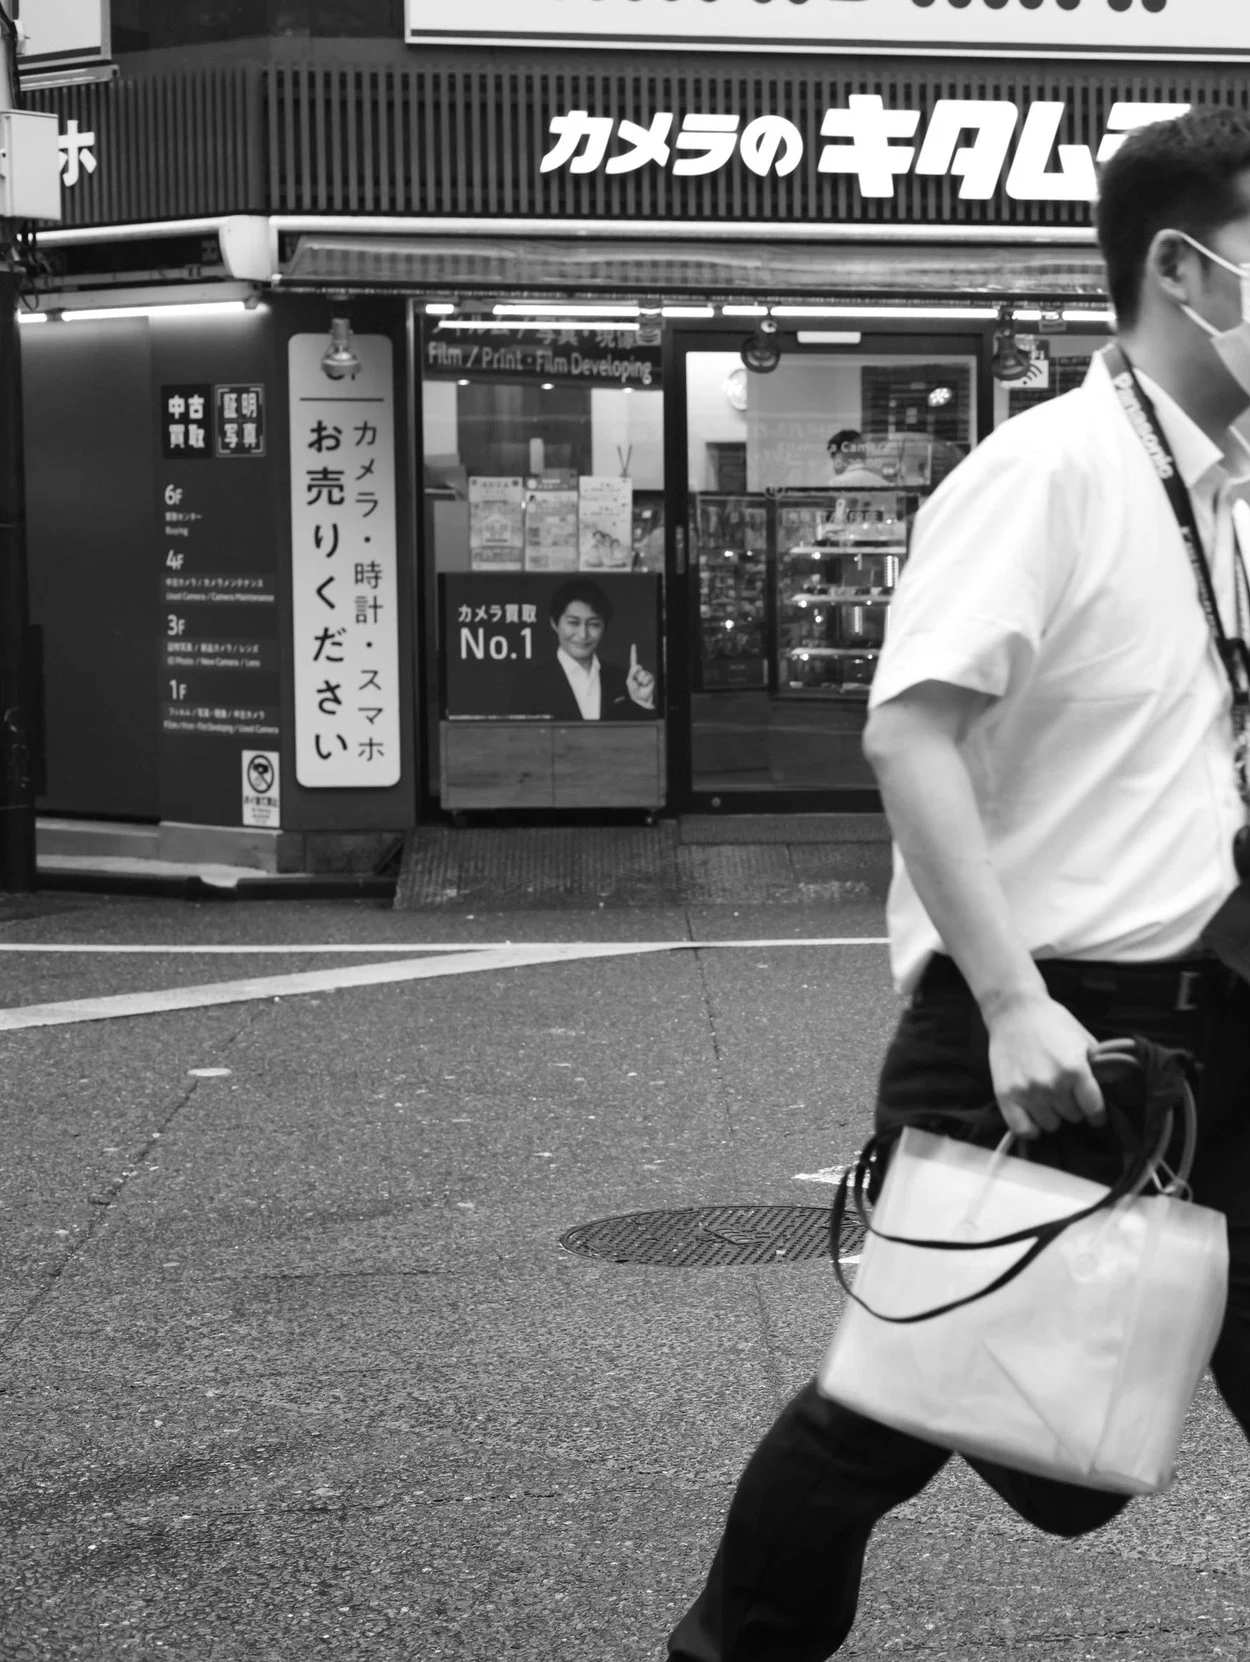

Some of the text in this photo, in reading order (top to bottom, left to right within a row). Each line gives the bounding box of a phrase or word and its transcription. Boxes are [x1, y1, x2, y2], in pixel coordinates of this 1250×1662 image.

[57, 119, 97, 187] ホ
[428, 341, 462, 366] Film
[482, 347, 523, 371] Print
[535, 350, 568, 375] Film
[570, 352, 653, 386] Developing
[168, 394, 205, 419] 中古
[223, 393, 258, 418] 証明
[168, 424, 205, 448] 買取
[224, 423, 258, 448] 写真
[164, 484, 183, 506] 6F
[166, 550, 184, 570] 4F
[306, 419, 348, 760] お売りください
[352, 419, 386, 762] カメラ・時計・スマホ
[167, 614, 185, 635] 3F
[458, 604, 537, 623] カメラ買取
[460, 627, 532, 660] No.1
[169, 679, 187, 700] 1F
